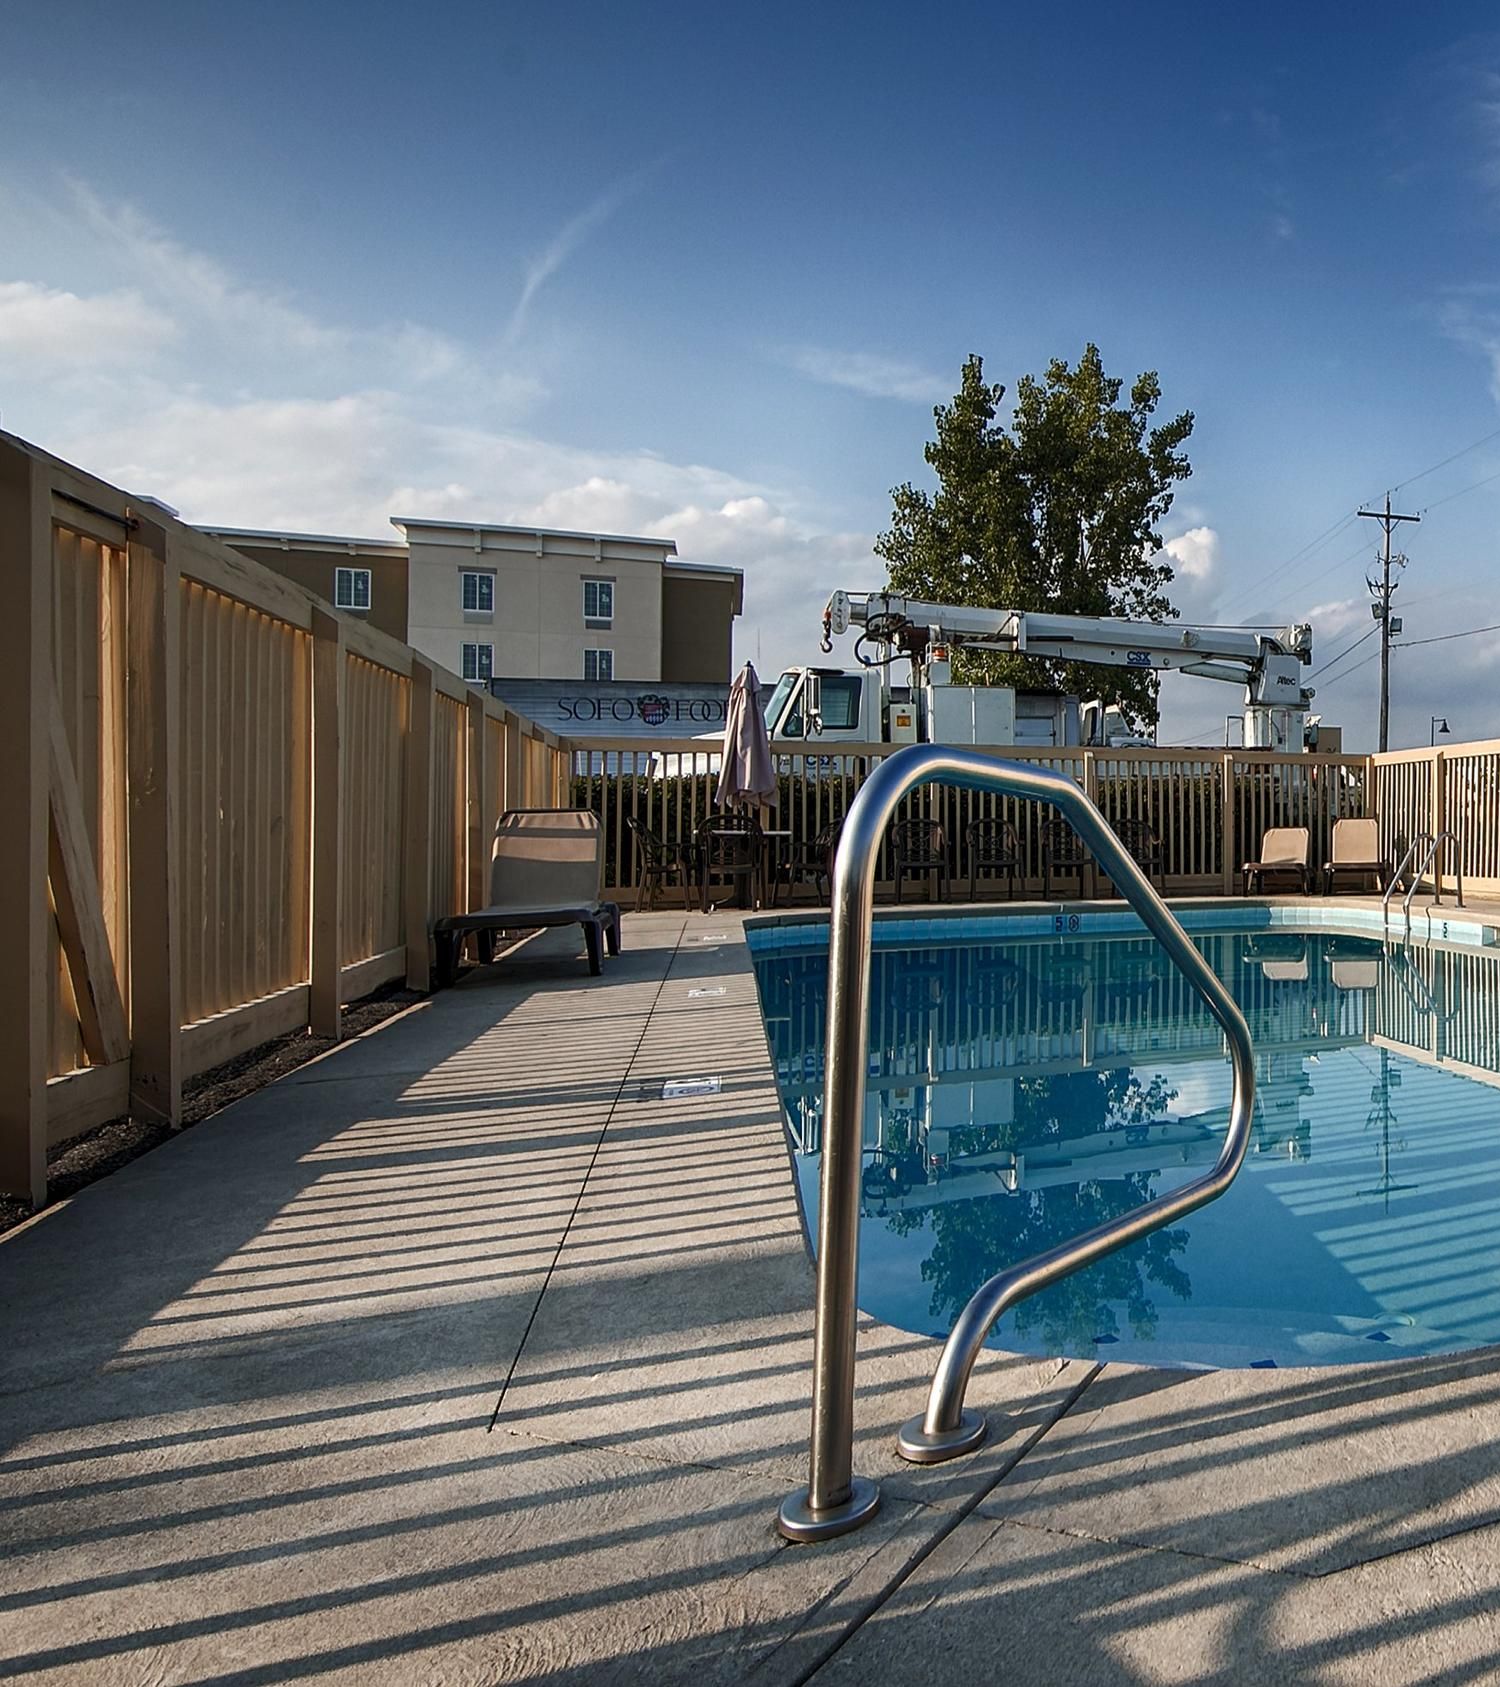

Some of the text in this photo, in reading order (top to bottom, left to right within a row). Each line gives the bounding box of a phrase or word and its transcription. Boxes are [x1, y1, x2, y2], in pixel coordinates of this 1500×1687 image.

[1126, 651, 1150, 663] CSX
[557, 697, 729, 722] SOFO FOO
